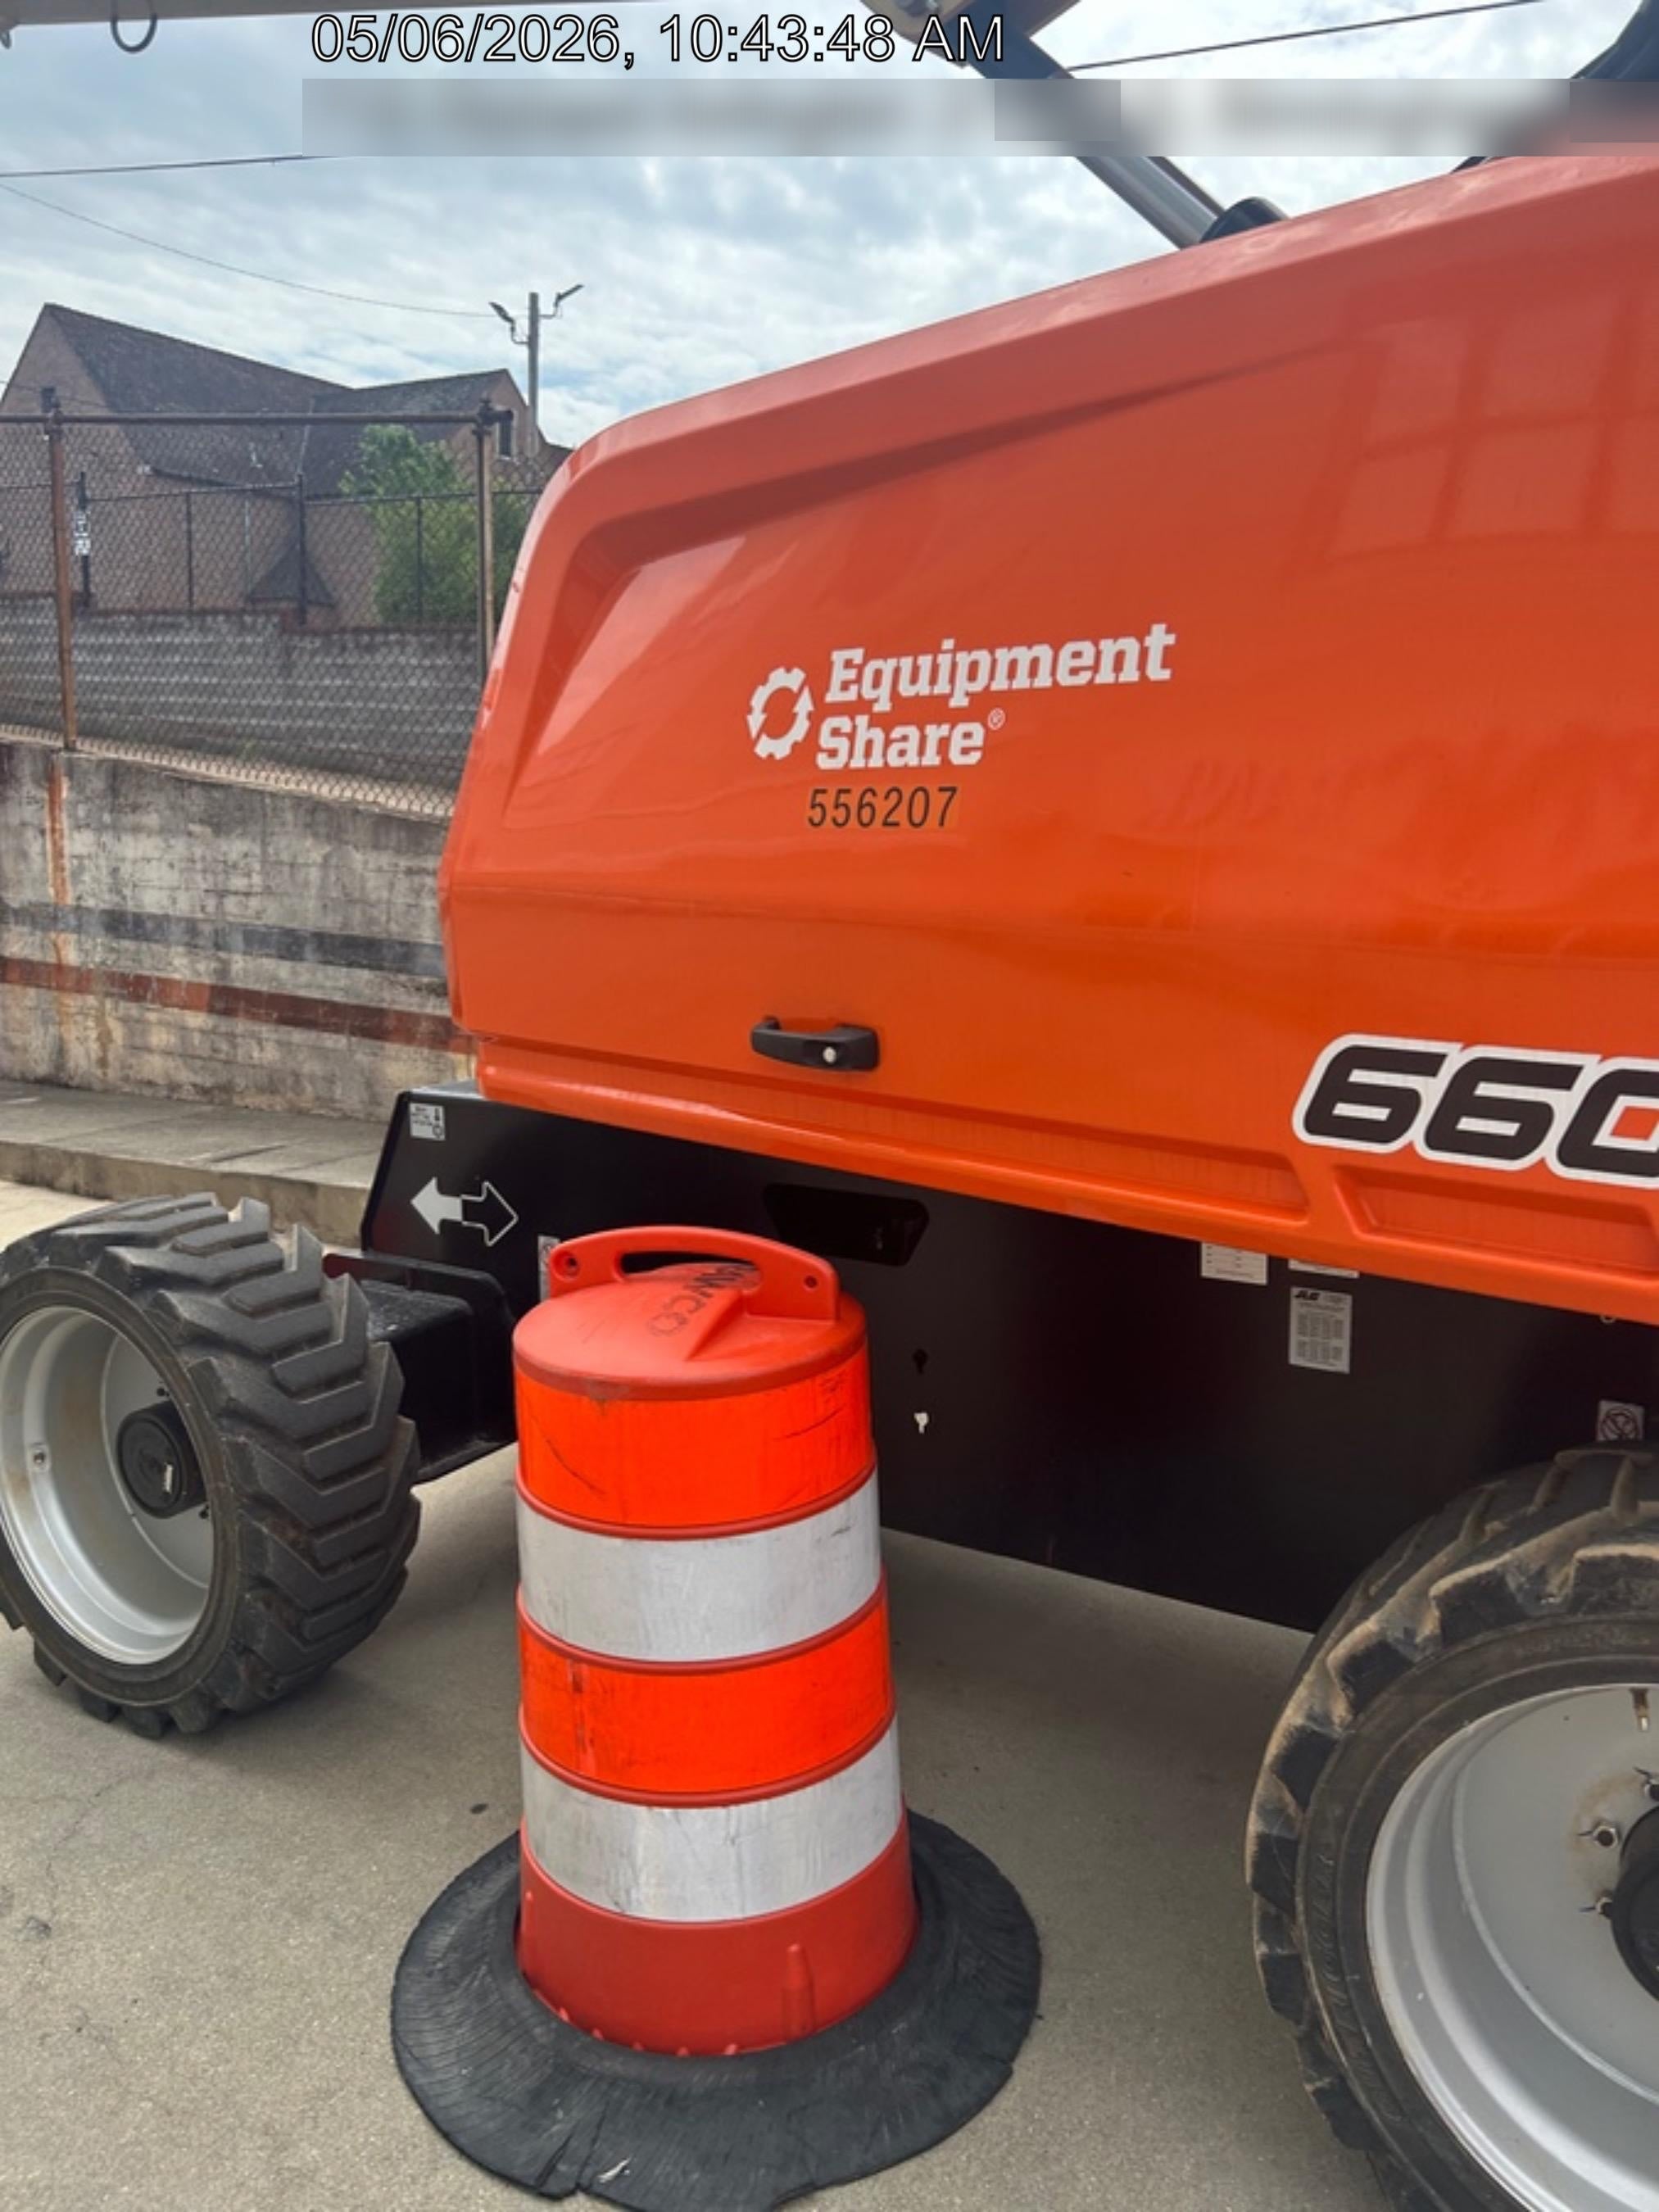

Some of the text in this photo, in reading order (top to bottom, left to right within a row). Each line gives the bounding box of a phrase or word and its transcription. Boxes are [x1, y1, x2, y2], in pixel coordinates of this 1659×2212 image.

[824, 623, 1176, 713] Equipment
[808, 786, 959, 829] 556207
[1293, 1034, 1659, 1190] 660
